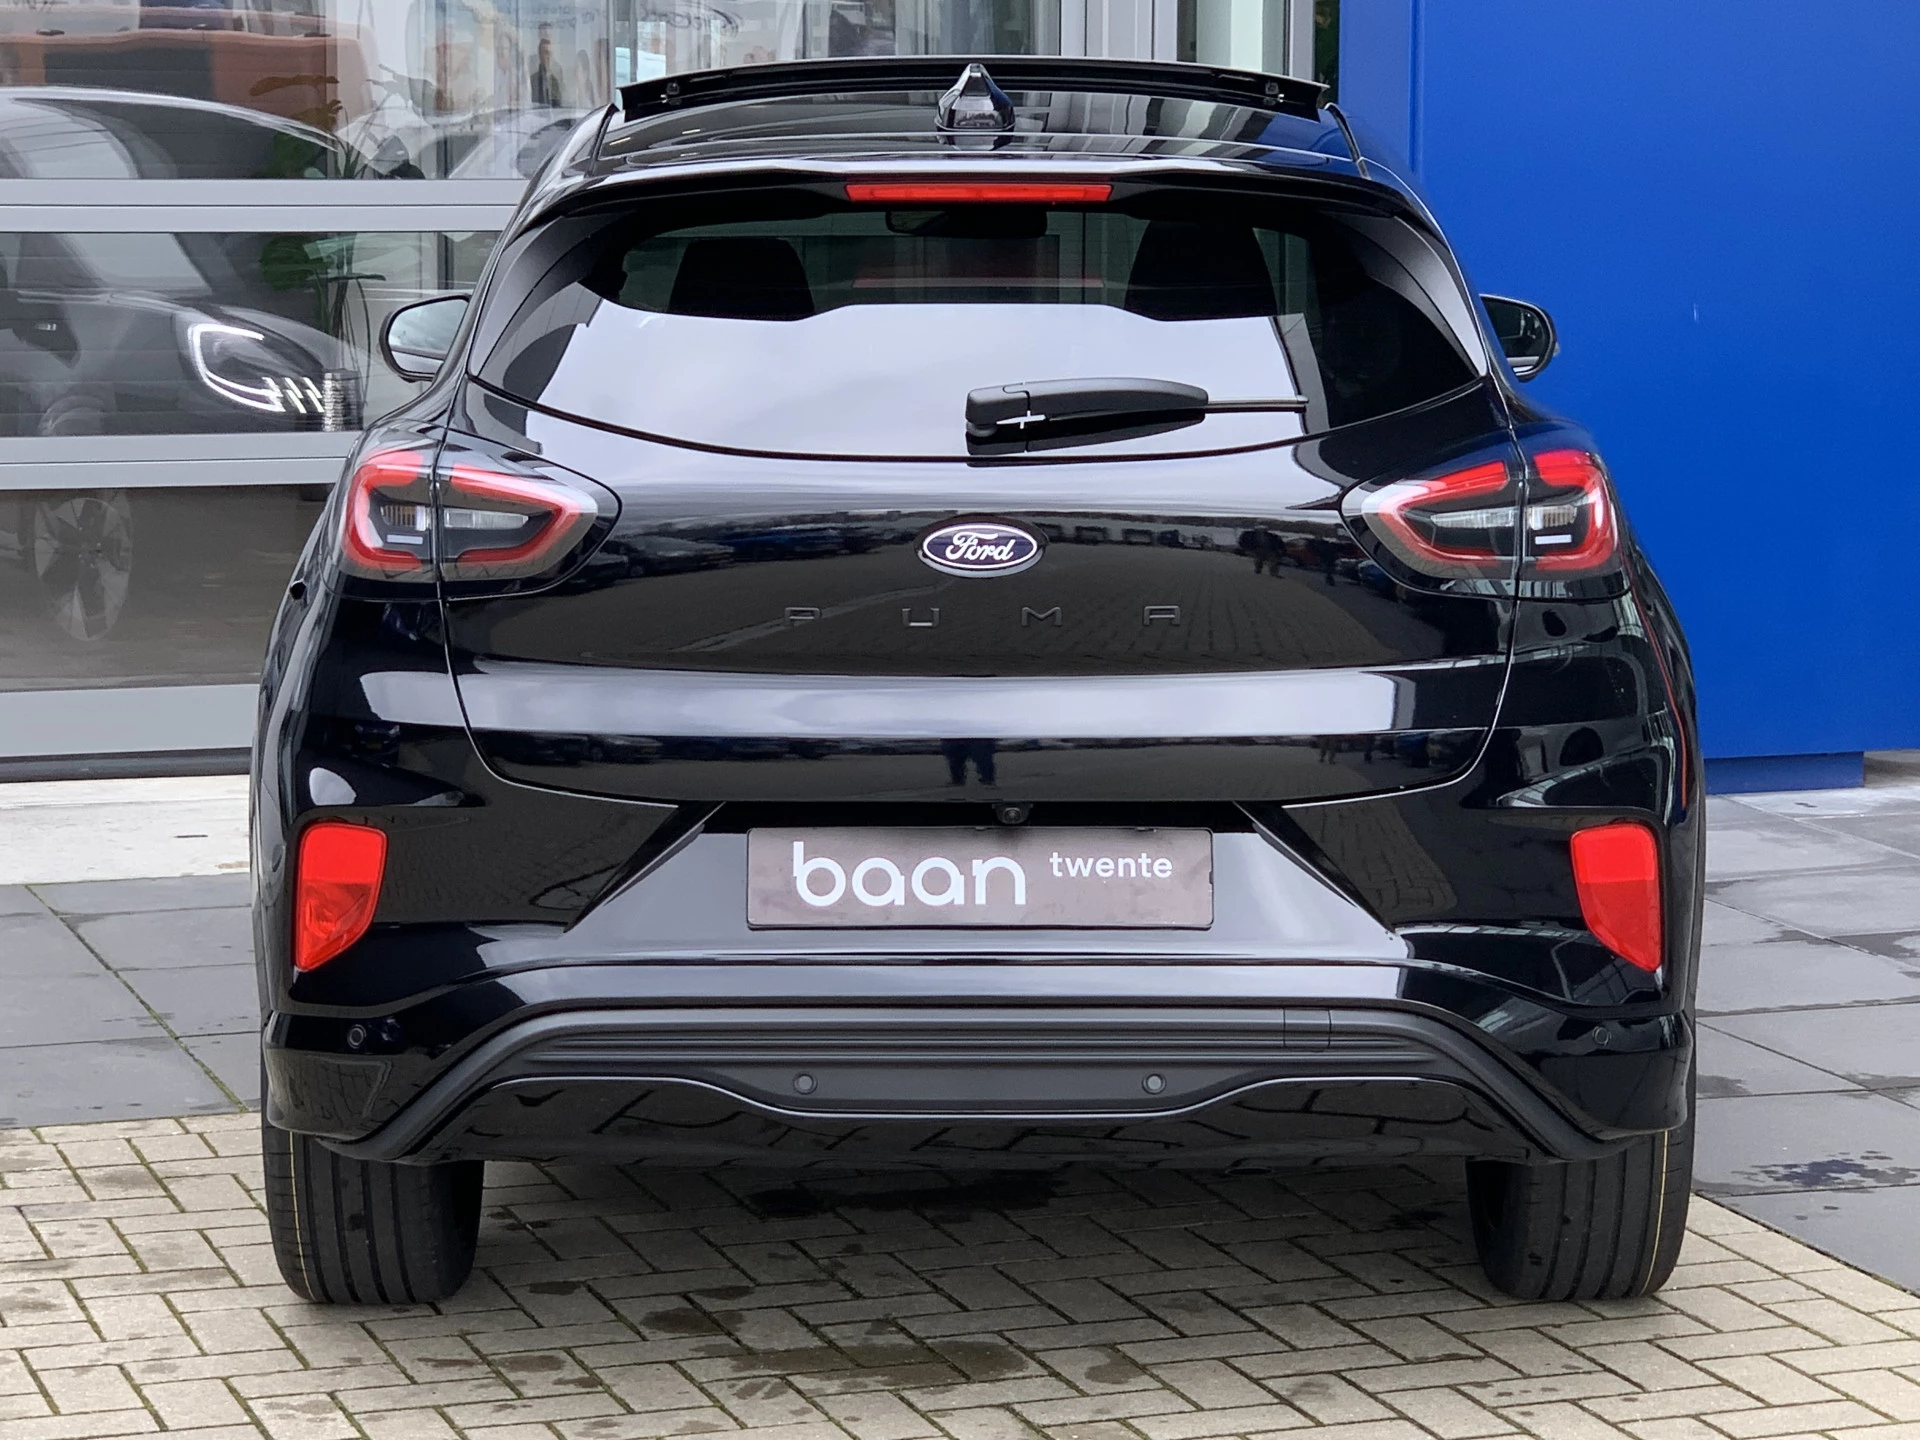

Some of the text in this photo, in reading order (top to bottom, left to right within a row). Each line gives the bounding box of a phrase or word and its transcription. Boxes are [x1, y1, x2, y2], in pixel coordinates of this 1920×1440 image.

[945, 531, 1016, 560] Ford
[785, 605, 1181, 627] PUMA
[793, 841, 1173, 906] baan twente
